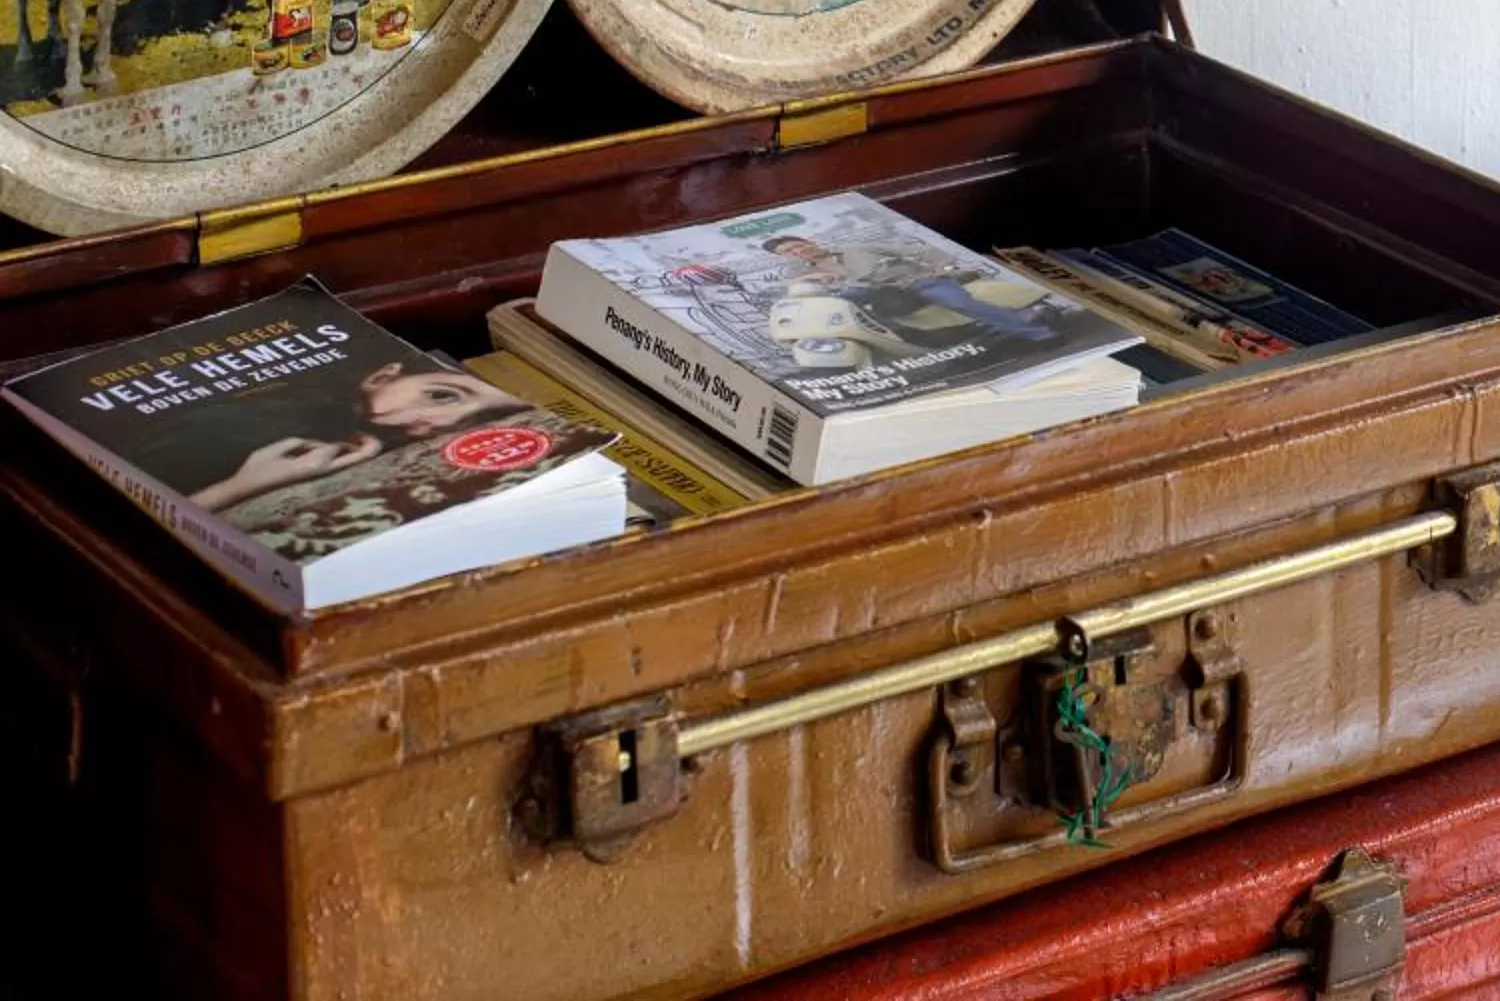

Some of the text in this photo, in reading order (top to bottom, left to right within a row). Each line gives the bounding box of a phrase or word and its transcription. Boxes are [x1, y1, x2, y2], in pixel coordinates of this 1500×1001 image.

[926, 14, 964, 46] LTD
[80, 323, 351, 412] VELE HEMELS
[89, 319, 299, 388] GRIET OP DE BEECK
[136, 347, 349, 415] BOVEN DE ZEVENDE
[605, 305, 653, 351] Penang's
[651, 337, 692, 380] History,
[693, 362, 711, 393] My
[712, 375, 743, 413] Story
[784, 342, 987, 390] Penang's History,
[801, 385, 843, 401] My
[841, 375, 909, 395] Story
